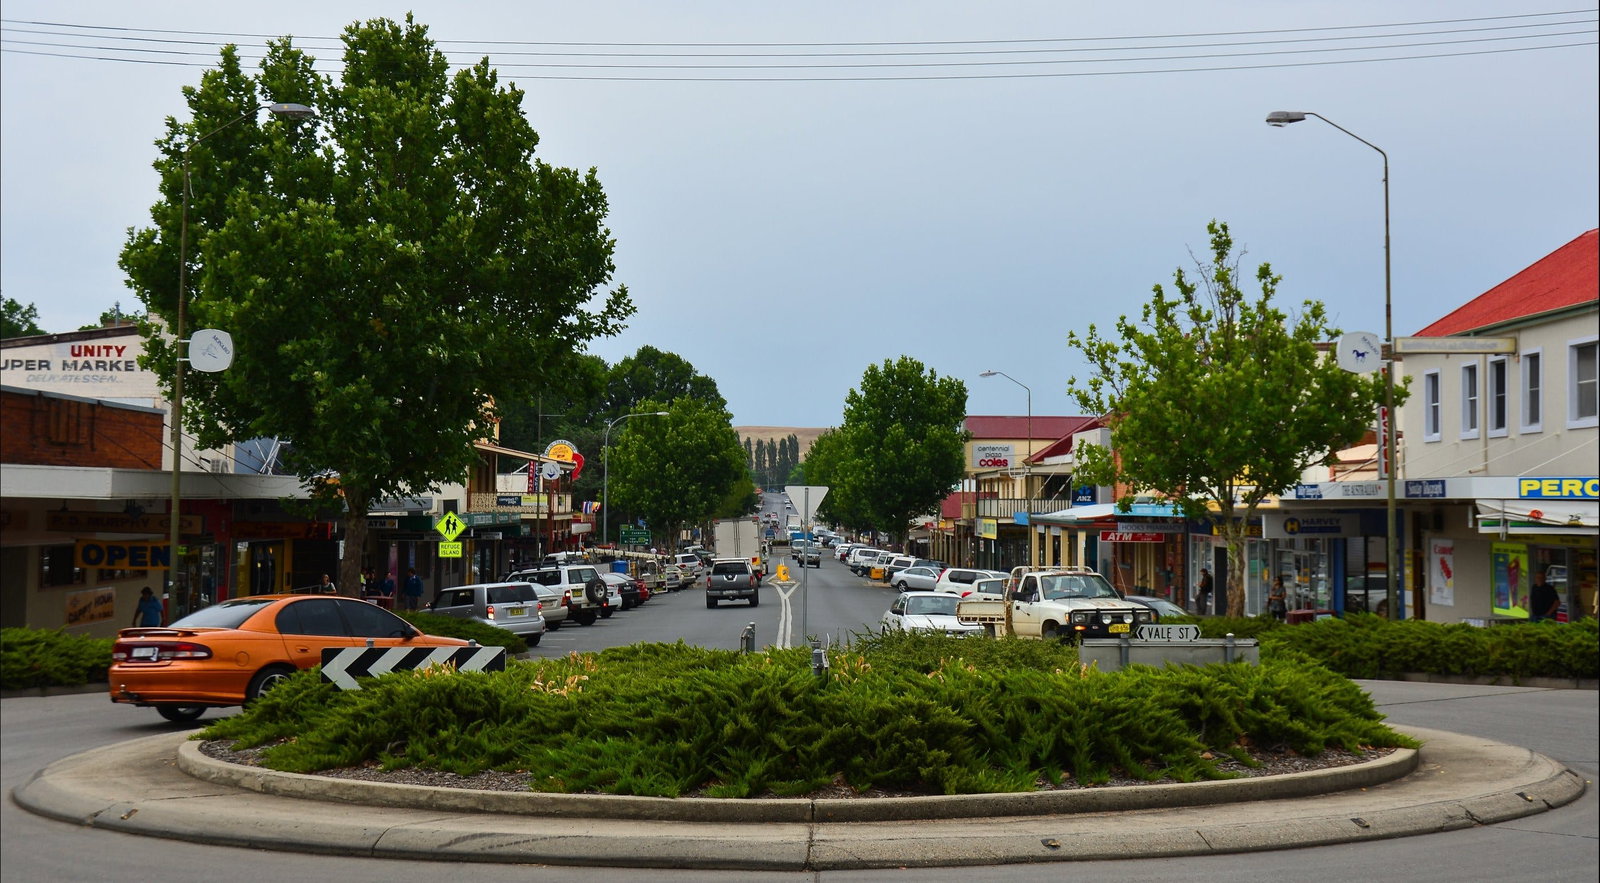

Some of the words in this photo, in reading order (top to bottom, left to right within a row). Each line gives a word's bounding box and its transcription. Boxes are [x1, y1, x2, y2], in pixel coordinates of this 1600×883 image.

[70, 345, 127, 358] UNITY
[62, 360, 142, 372] MARKE
[979, 457, 1008, 467] coles
[367, 519, 386, 527] ATM
[1121, 523, 1144, 531] HOOKS
[1107, 532, 1133, 541] ATM
[82, 544, 170, 567] OPEN
[1148, 627, 1172, 639] VALE
[1178, 627, 1190, 639] ST
